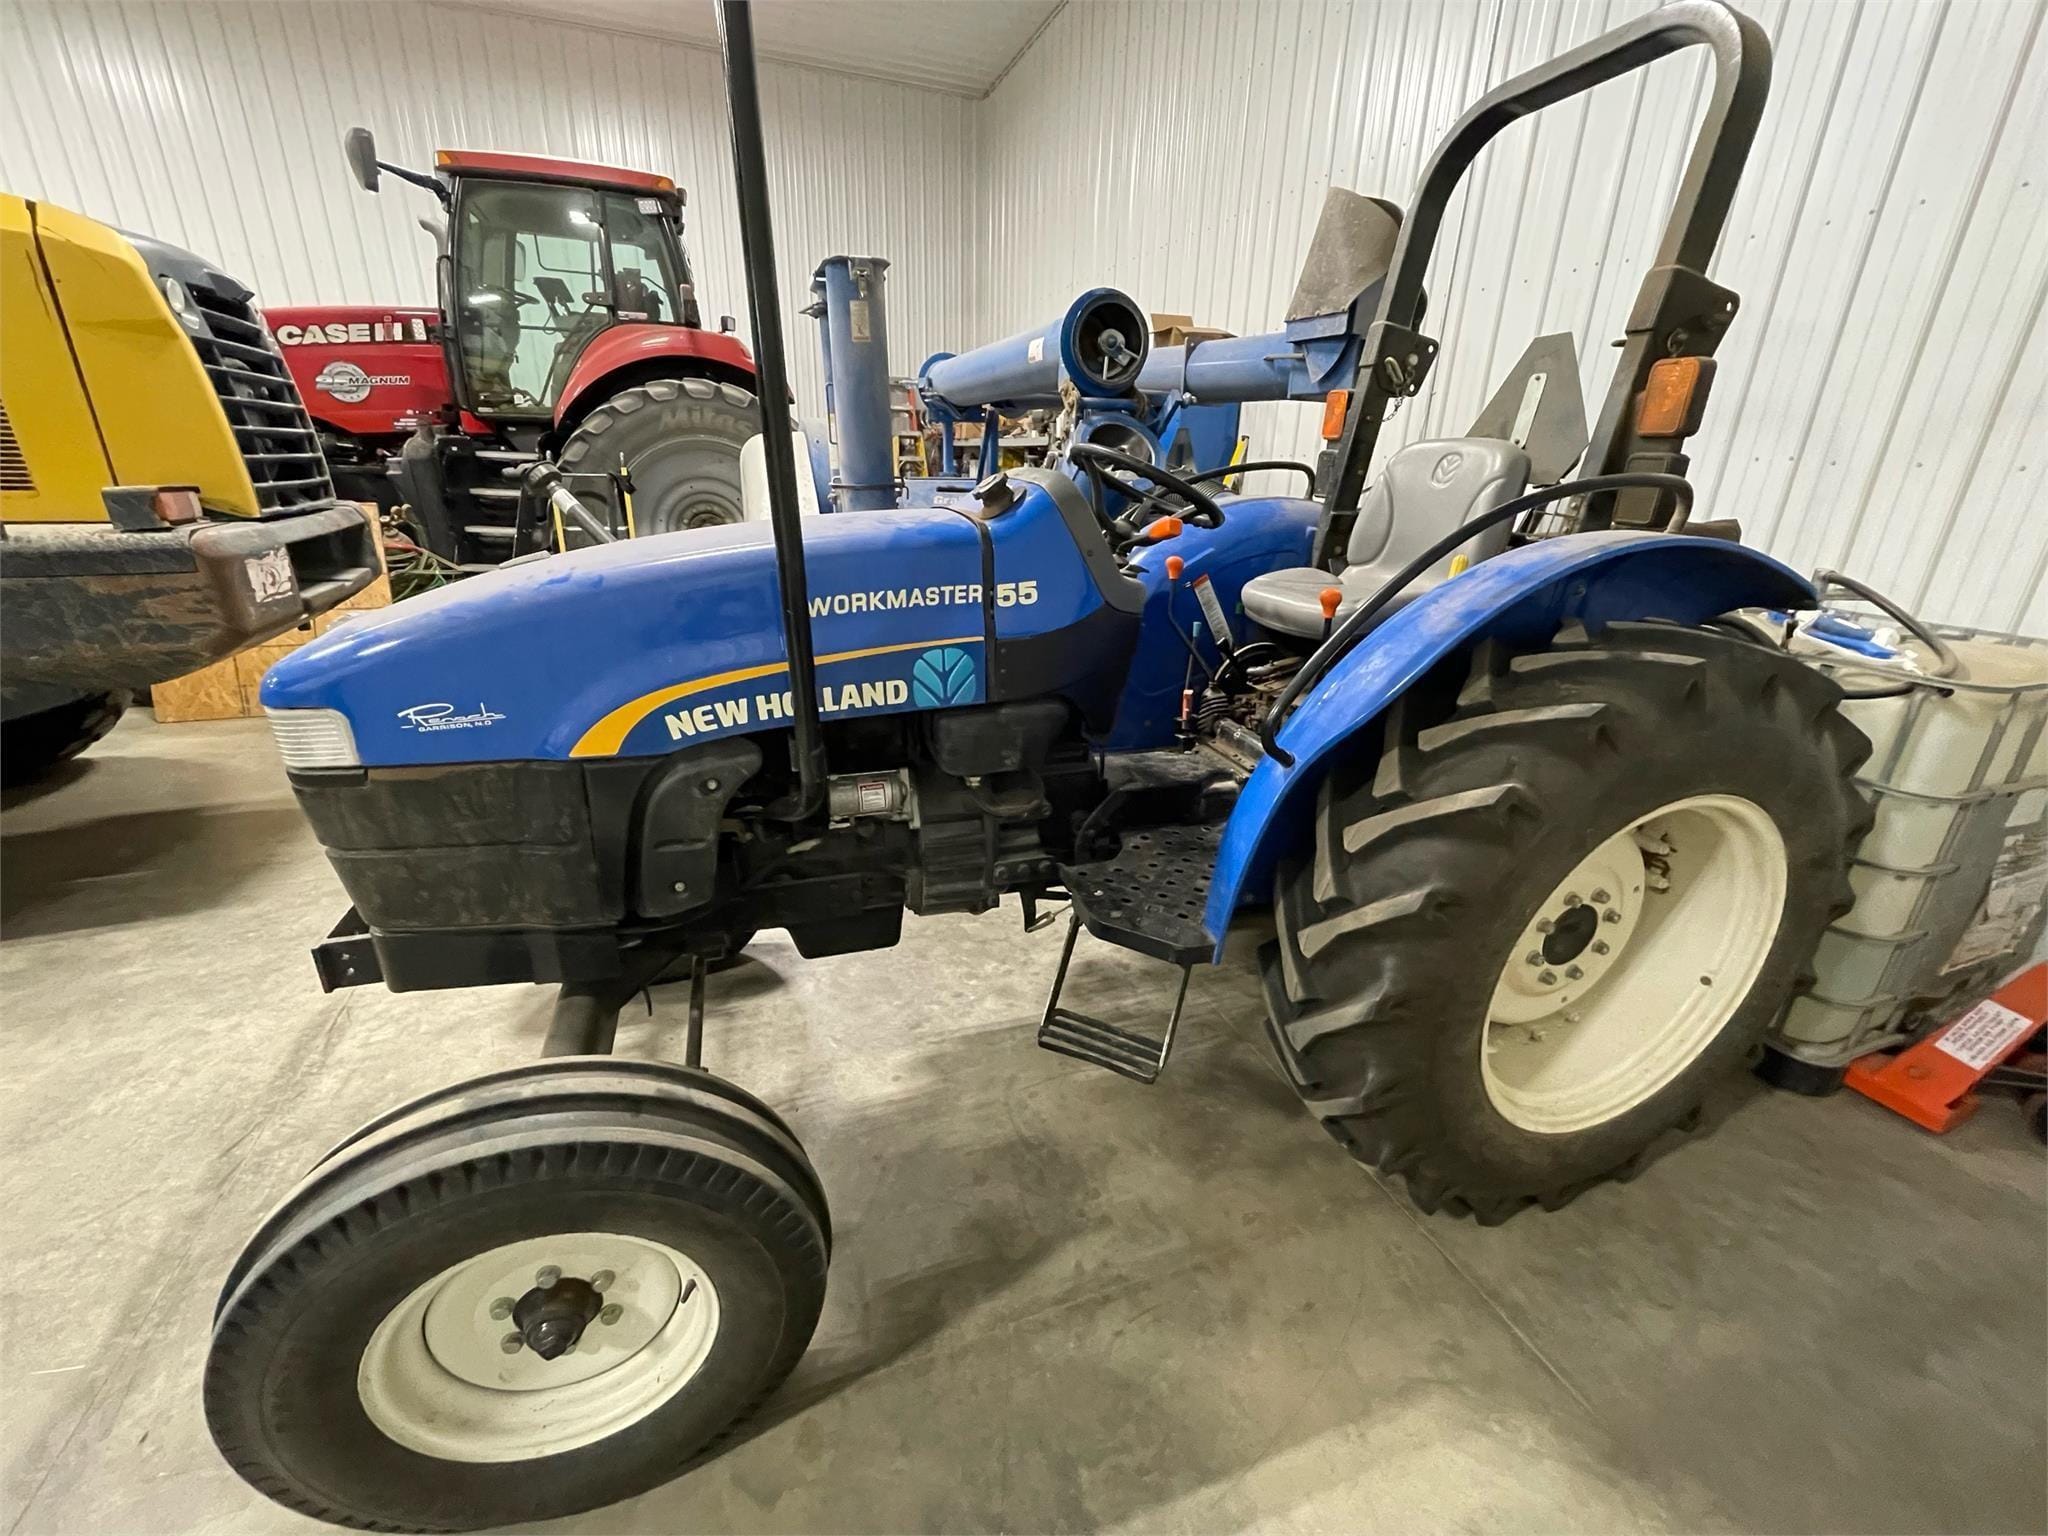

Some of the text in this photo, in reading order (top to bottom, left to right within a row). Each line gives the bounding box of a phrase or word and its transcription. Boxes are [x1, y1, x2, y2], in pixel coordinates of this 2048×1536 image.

[276, 323, 371, 346] CASE
[348, 374, 411, 386] MAGNUM
[808, 580, 1039, 618] WORKMASTER 55
[664, 697, 749, 741] NEW
